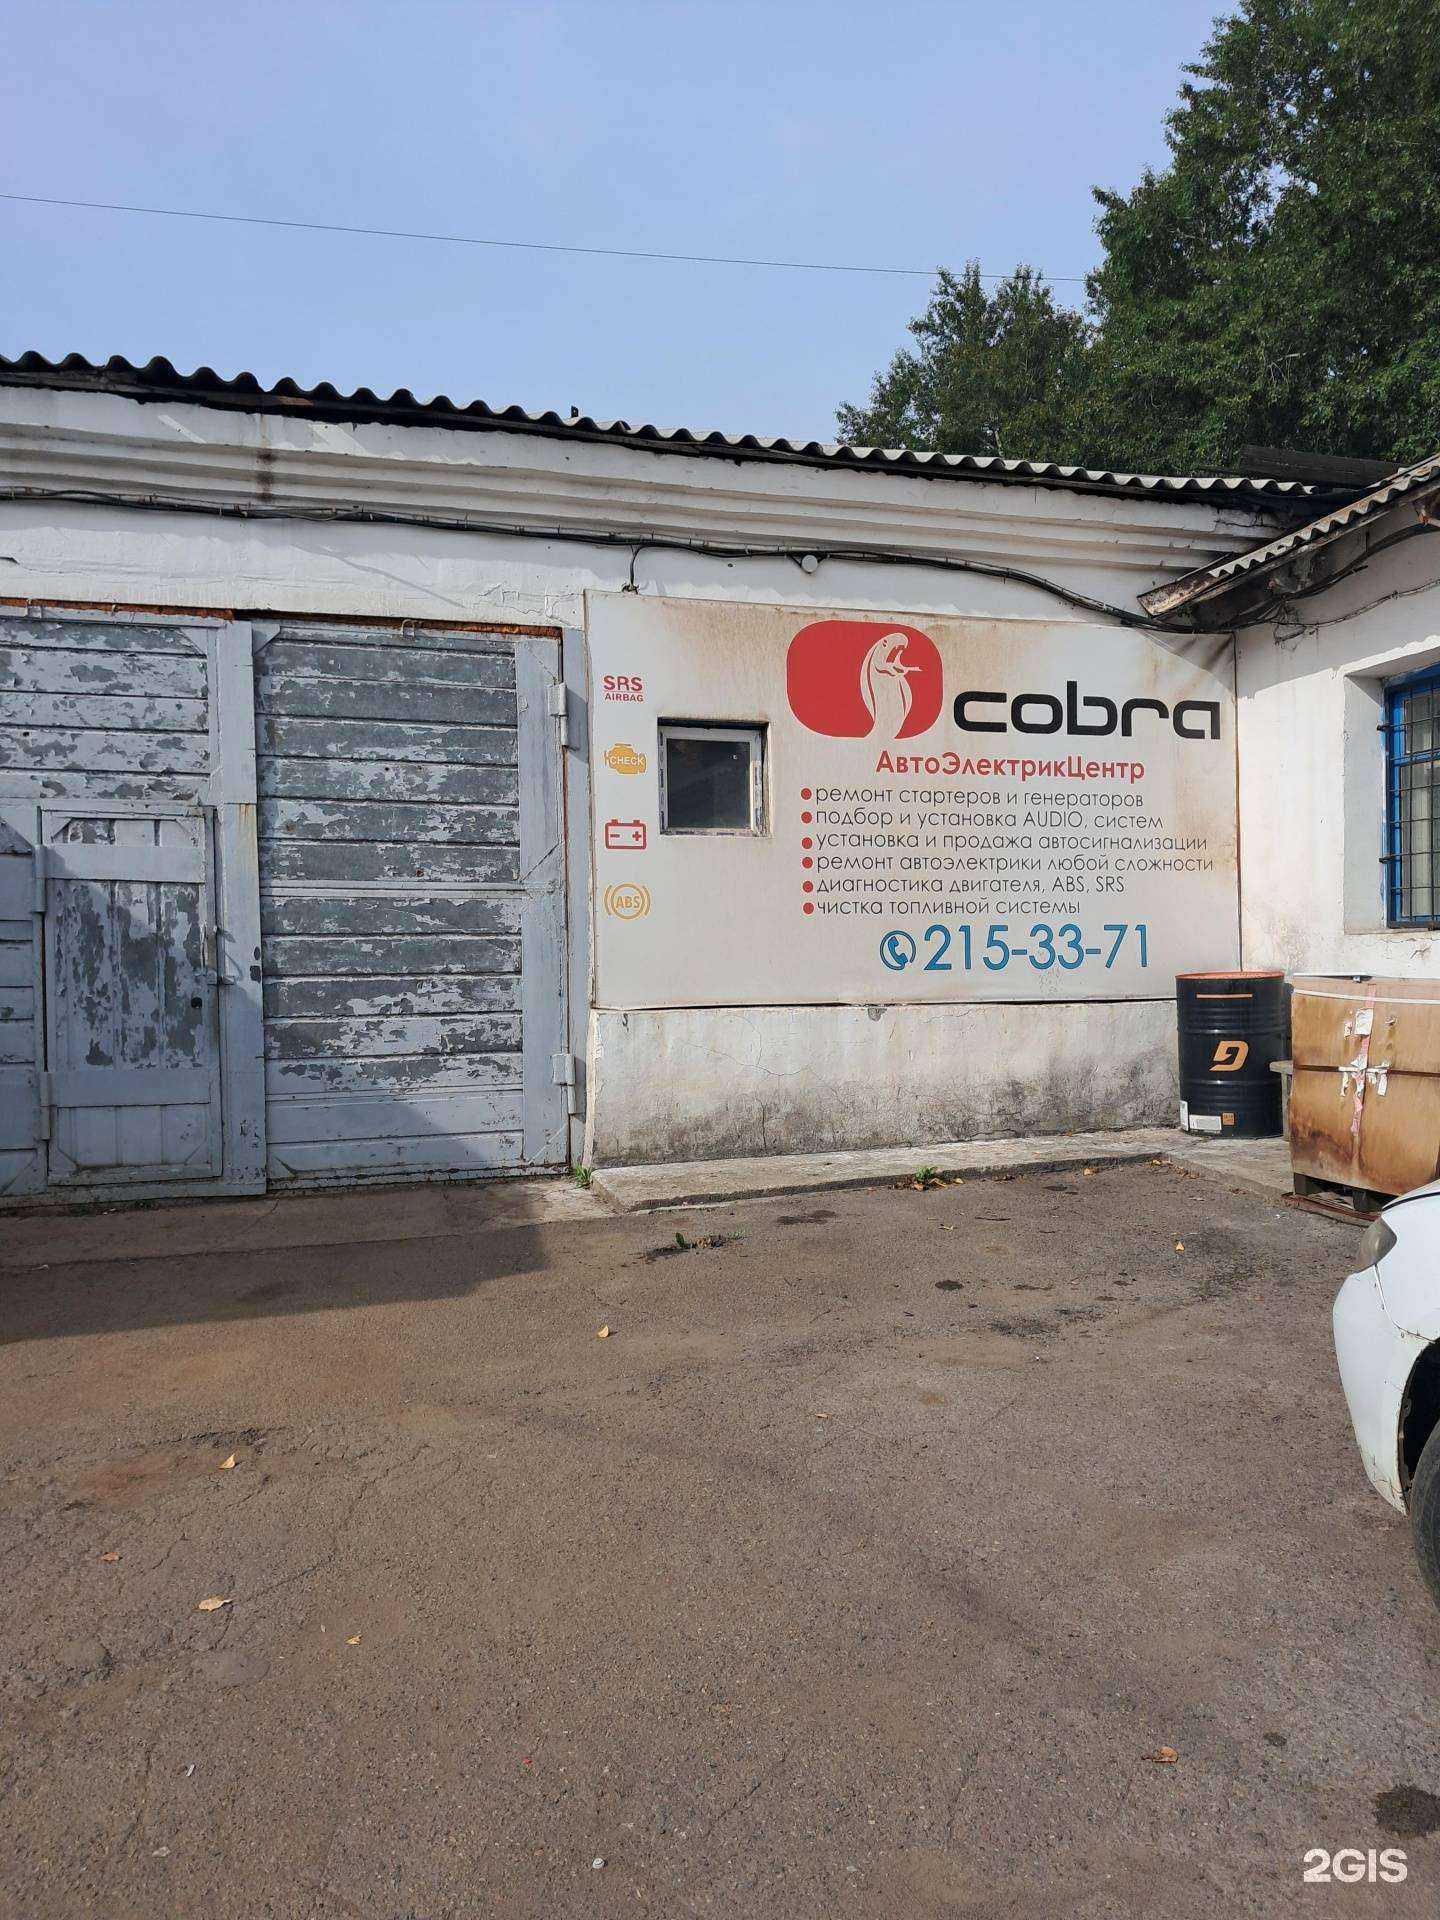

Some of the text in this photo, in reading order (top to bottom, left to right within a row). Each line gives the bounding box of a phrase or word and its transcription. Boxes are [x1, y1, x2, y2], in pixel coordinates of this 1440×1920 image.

[604, 675, 643, 691] SRS
[604, 693, 644, 702] AIRBAG
[954, 681, 1220, 740] cobra
[610, 756, 644, 765] CHECK
[875, 751, 1145, 783] АвтоЭлектрикЦентр
[816, 787, 1143, 809] ремонт стартеров и генераторов
[816, 808, 892, 829] подбор
[900, 813, 911, 825] и
[917, 813, 1016, 831] установка
[1094, 815, 1163, 829] систем
[816, 834, 1207, 853] установка и продажа автосигнализации
[817, 854, 1214, 874] ремонт автоэлектрики любой сложности
[817, 876, 1124, 896] диагностика двигателя, ABS, SRS
[616, 896, 640, 909] ABS
[817, 898, 1080, 915] чистка топливной системы
[924, 924, 1148, 970] 215-33-71
